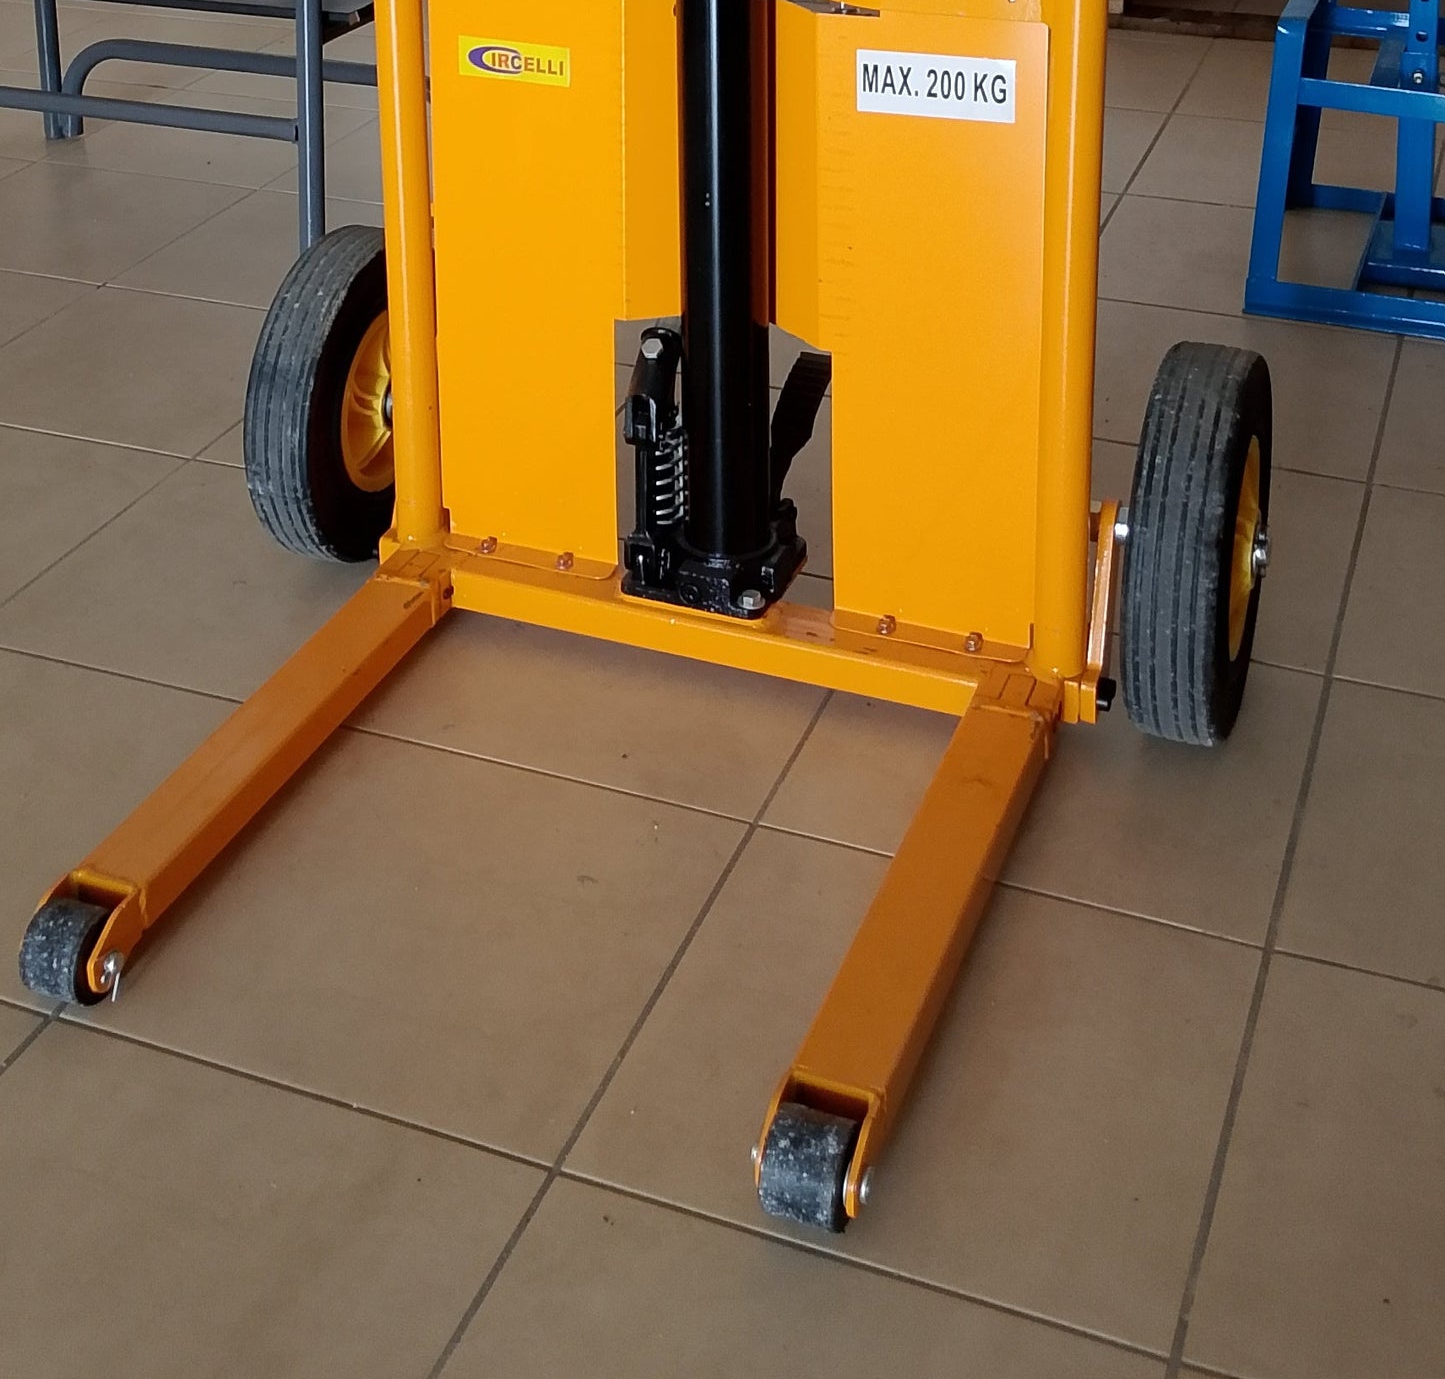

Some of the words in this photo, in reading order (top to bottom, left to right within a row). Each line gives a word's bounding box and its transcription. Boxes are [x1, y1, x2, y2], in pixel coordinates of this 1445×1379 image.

[468, 46, 563, 76] CIRCELLI
[863, 63, 918, 97] MAX.
[926, 69, 965, 100] 200
[973, 72, 1007, 104] KG
